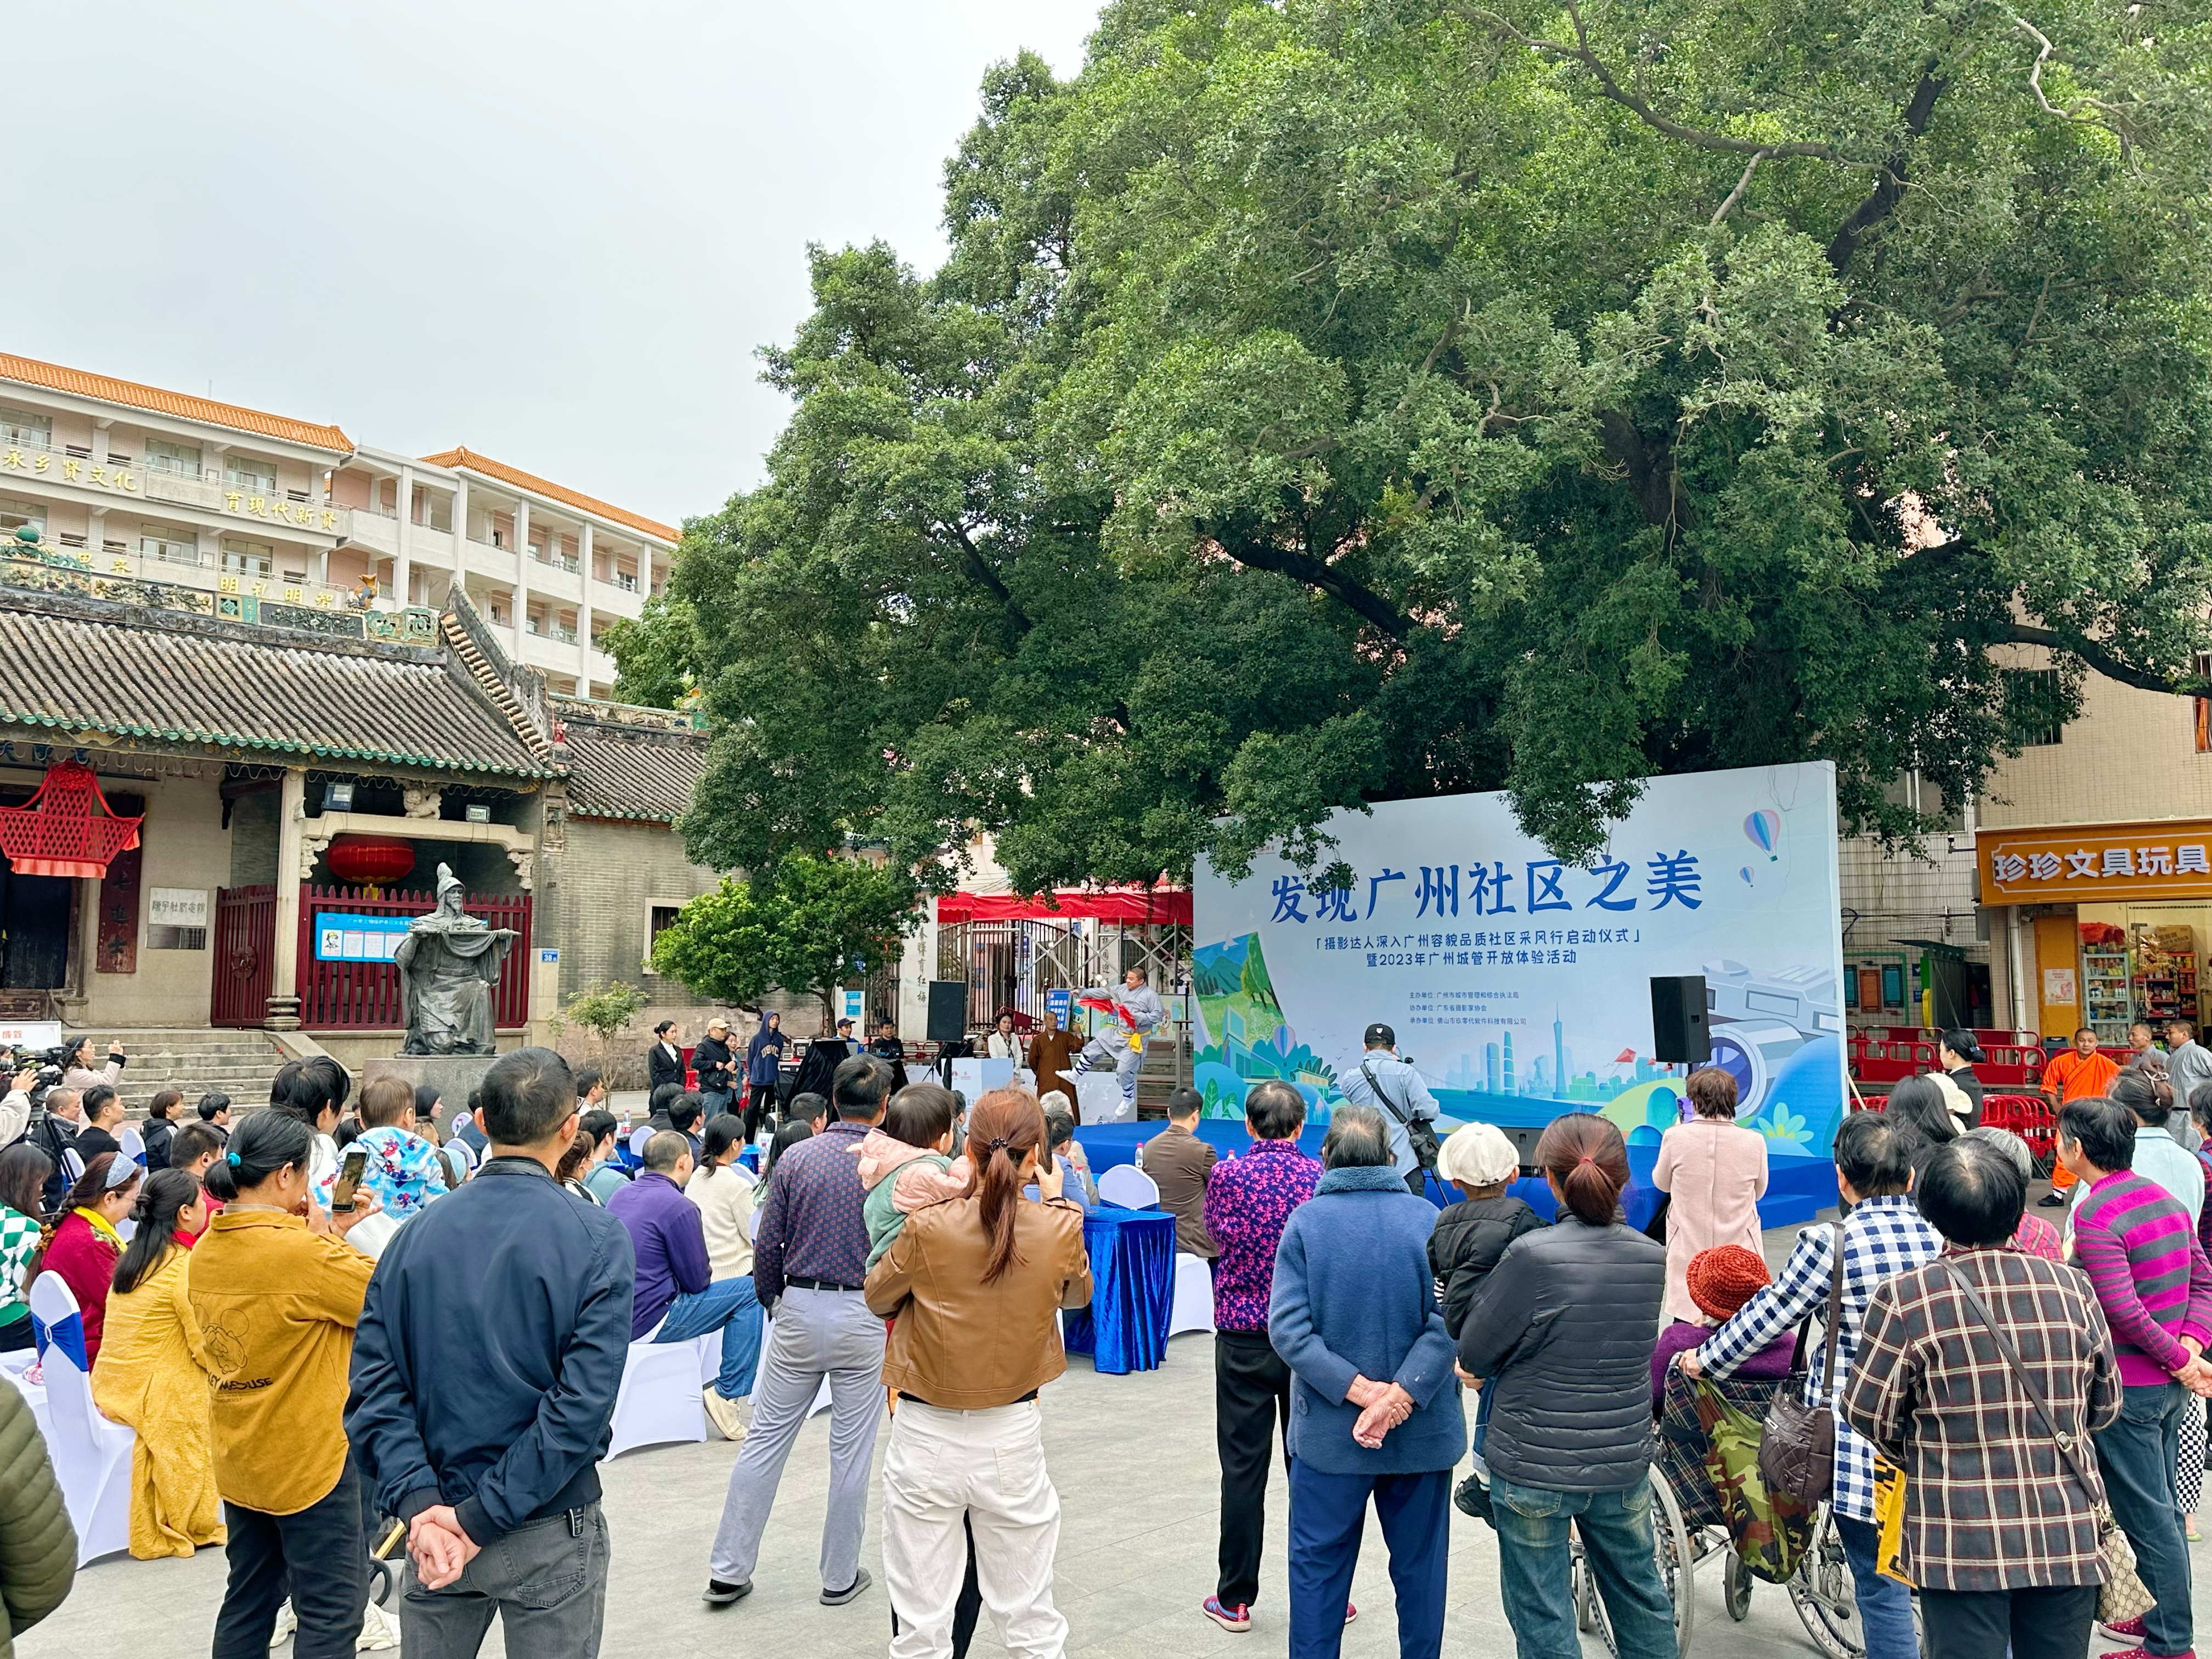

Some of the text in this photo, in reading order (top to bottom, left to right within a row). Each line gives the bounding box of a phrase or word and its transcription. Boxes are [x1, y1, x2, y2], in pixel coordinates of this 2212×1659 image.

[3, 448, 137, 492] 承乡贤文化
[225, 492, 337, 531] 育现代新贤
[220, 577, 334, 609] 明礼明智
[1994, 844, 2210, 882] 珍珍文具玩具
[1270, 849, 1703, 924] 发现广州社区之美
[1317, 928, 1640, 950] 「摄影达人深入广州容貌品质社区采风行启动仪式」
[1367, 949, 1577, 967] 暨2023年广州城管开放体验活动
